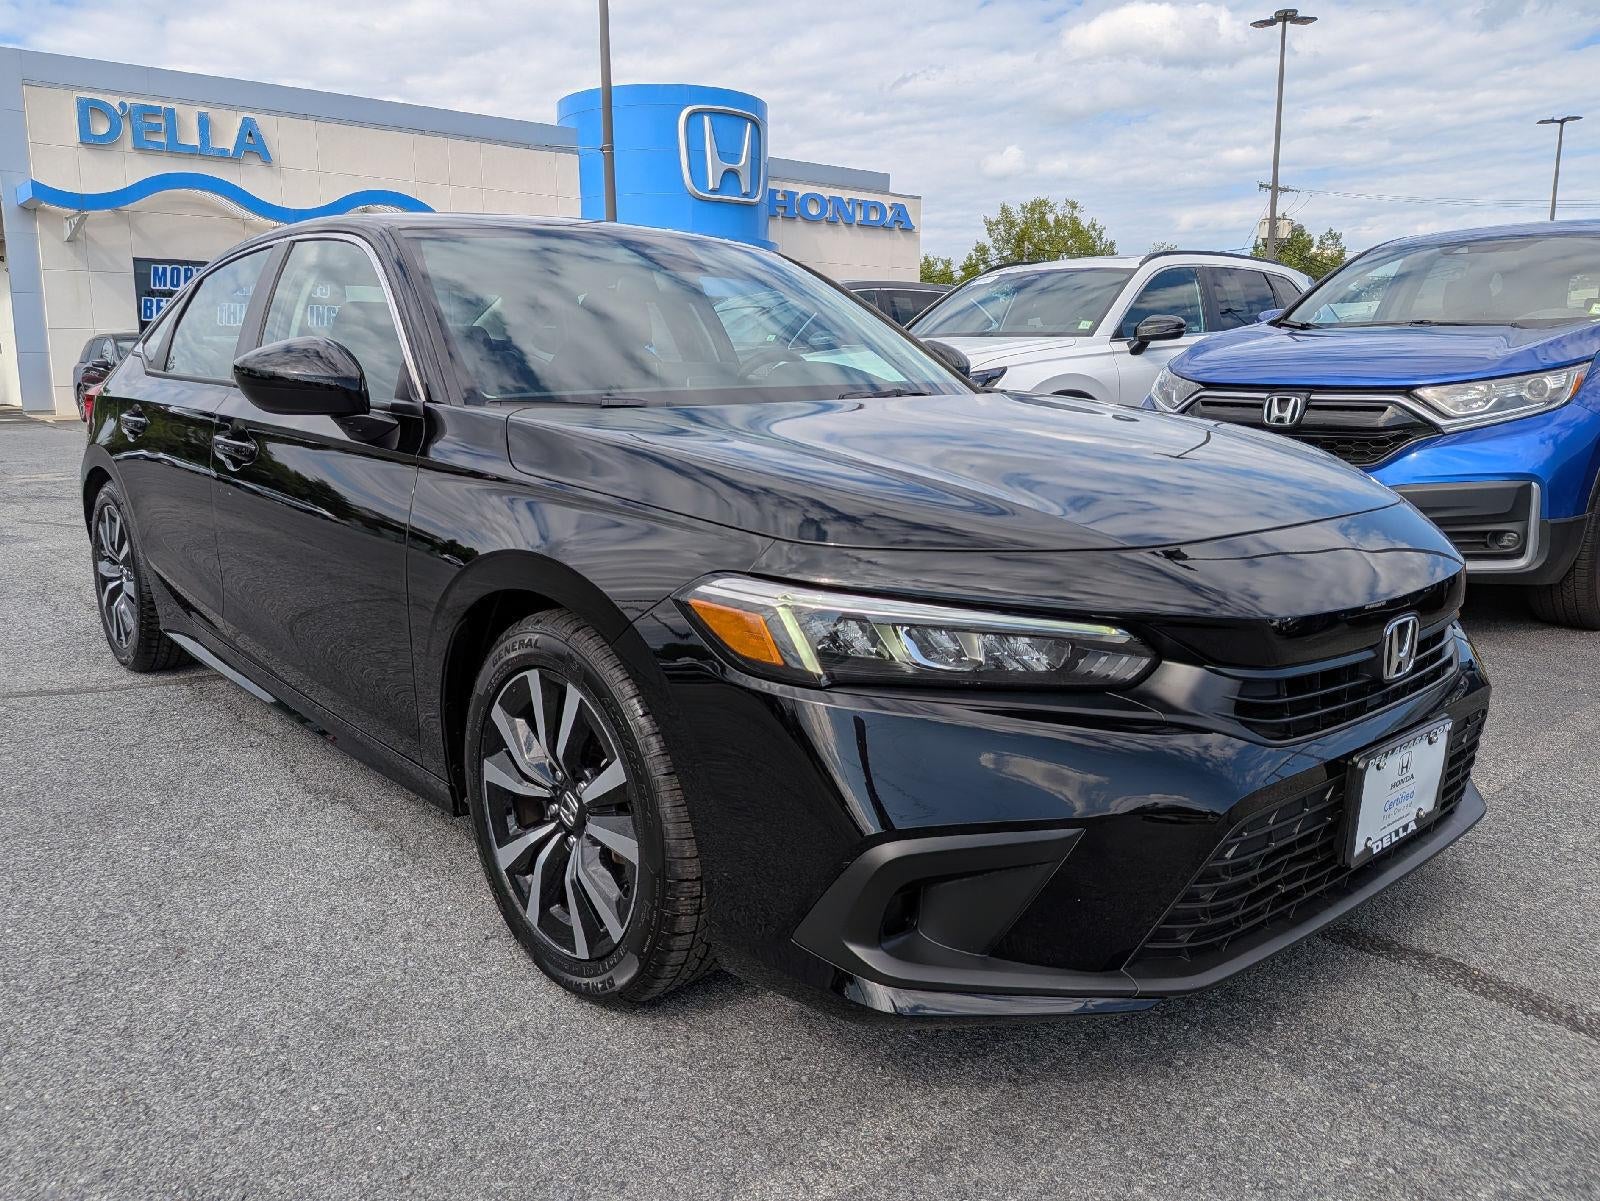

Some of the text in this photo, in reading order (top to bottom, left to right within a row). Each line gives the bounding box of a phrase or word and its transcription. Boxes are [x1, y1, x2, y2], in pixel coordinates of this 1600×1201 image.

[76, 96, 272, 163] D'ELLA
[768, 188, 915, 230] HONDA
[151, 264, 203, 290] MOR
[492, 638, 541, 668] GENERAL
[1390, 773, 1415, 790] HONDA
